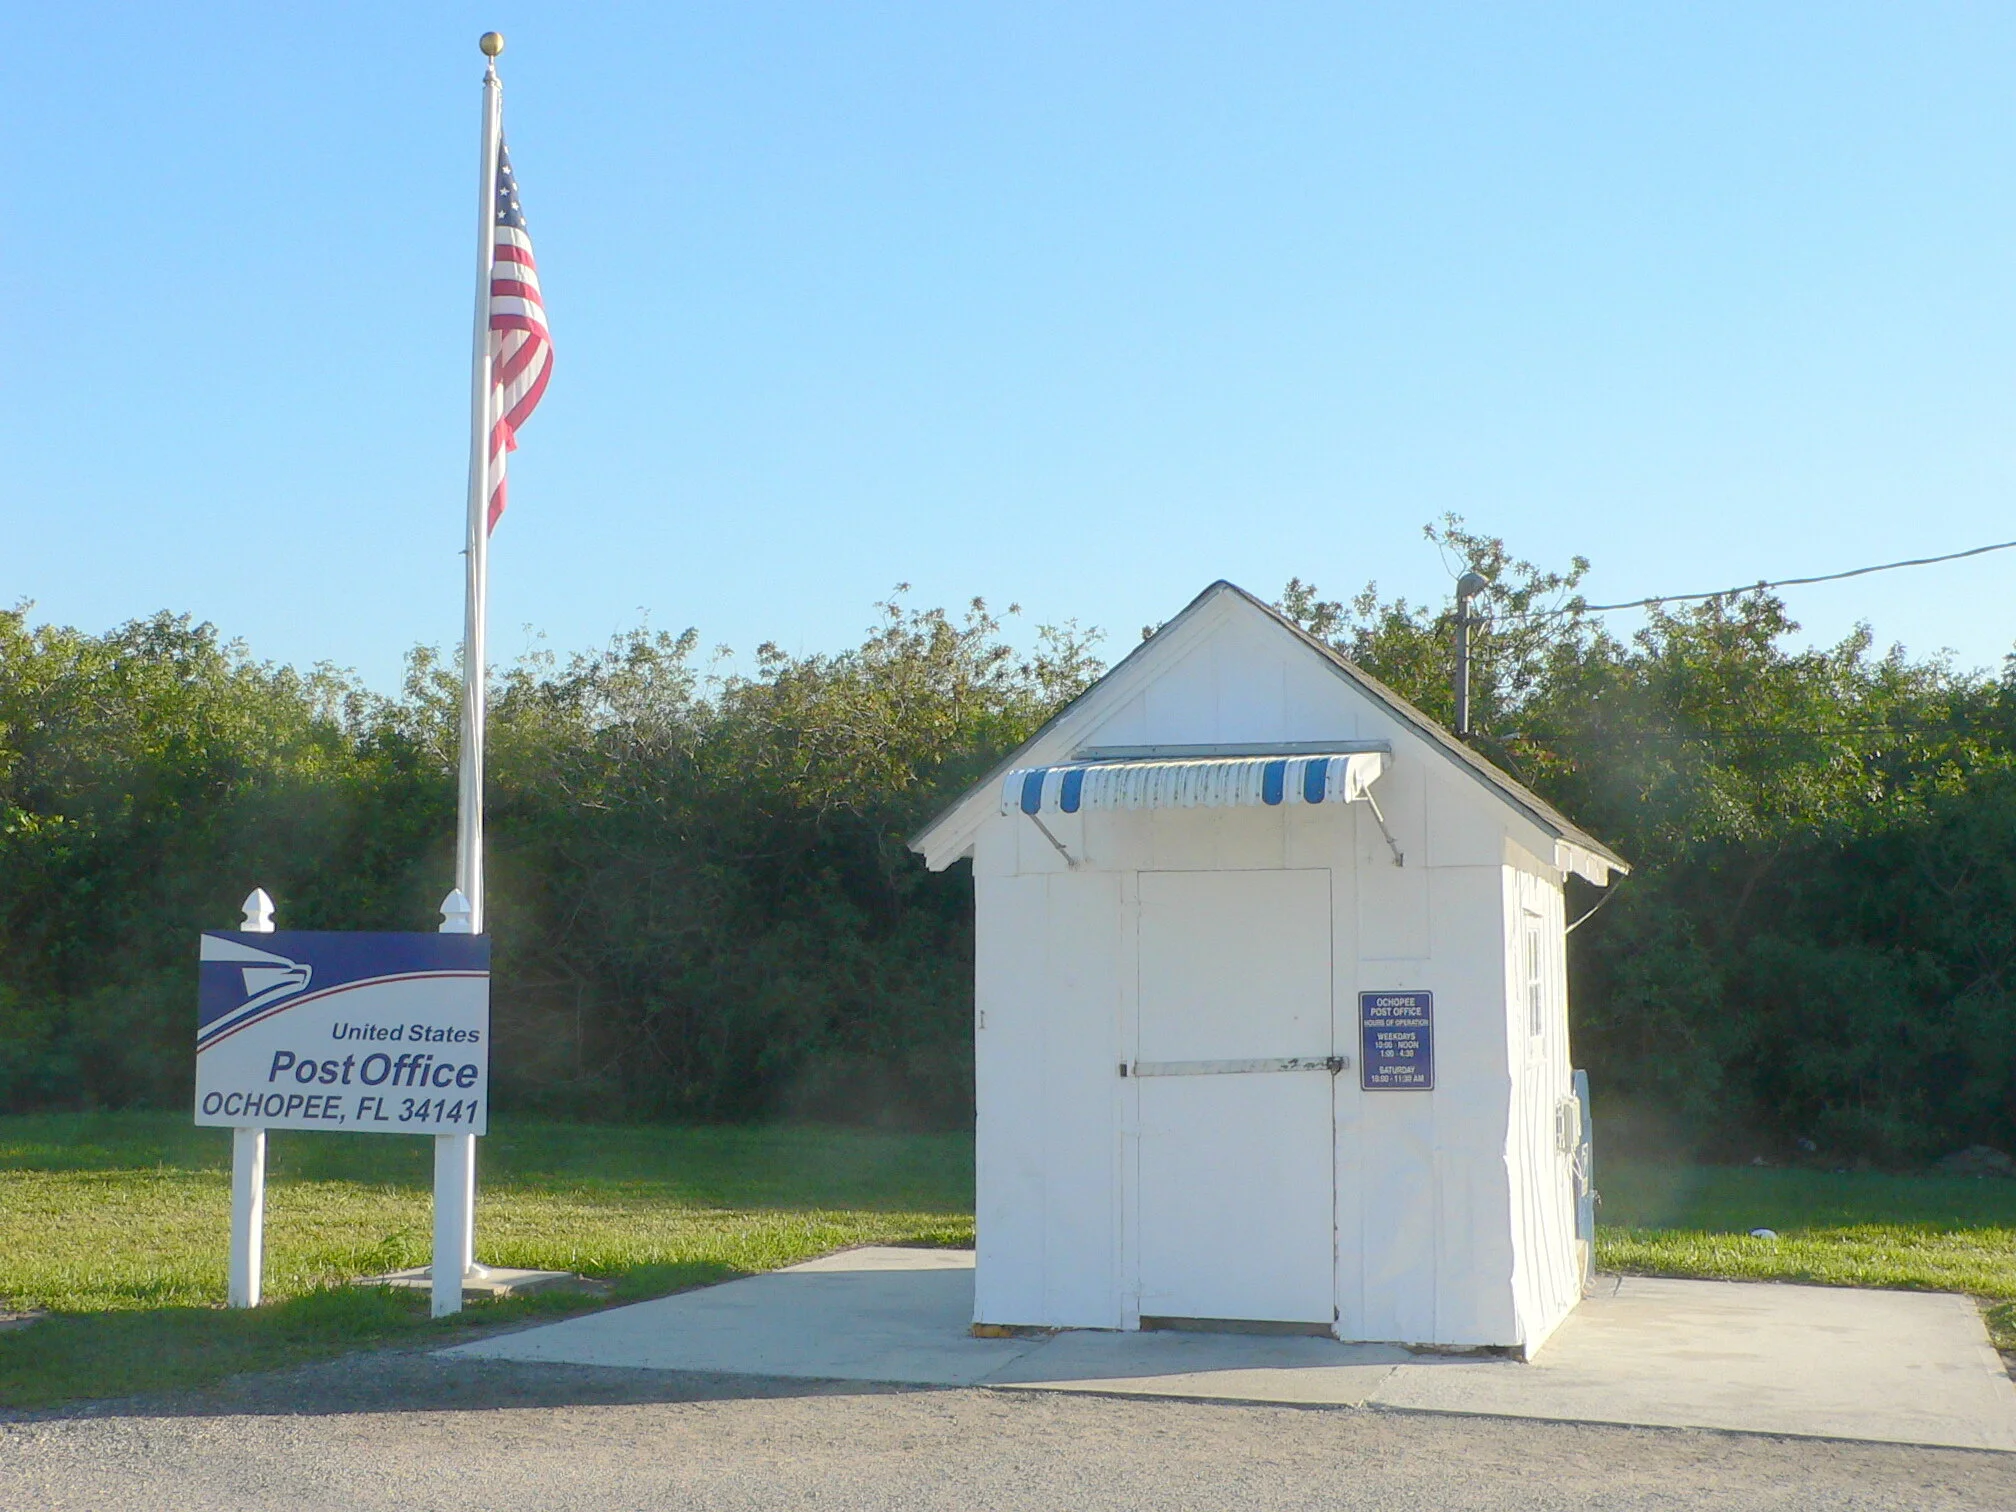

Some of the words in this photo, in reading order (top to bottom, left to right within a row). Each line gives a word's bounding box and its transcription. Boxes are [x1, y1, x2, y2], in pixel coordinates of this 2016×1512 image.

[1376, 998, 1416, 1007] OCHOPEE
[1370, 1008, 1392, 1016] POST
[1393, 1007, 1421, 1016] OFFICE
[332, 1022, 403, 1041] United
[408, 1024, 480, 1043] States
[1377, 1032, 1416, 1041] WEEKDAYS
[1398, 1041, 1419, 1049] NOON
[268, 1050, 355, 1085] Post
[359, 1053, 479, 1089] Office
[1379, 1066, 1416, 1075] SATURDAY
[1413, 1075, 1425, 1083] AM
[202, 1091, 347, 1124] OCHOPEE,
[356, 1096, 389, 1121] FL
[398, 1098, 479, 1123] 34141
